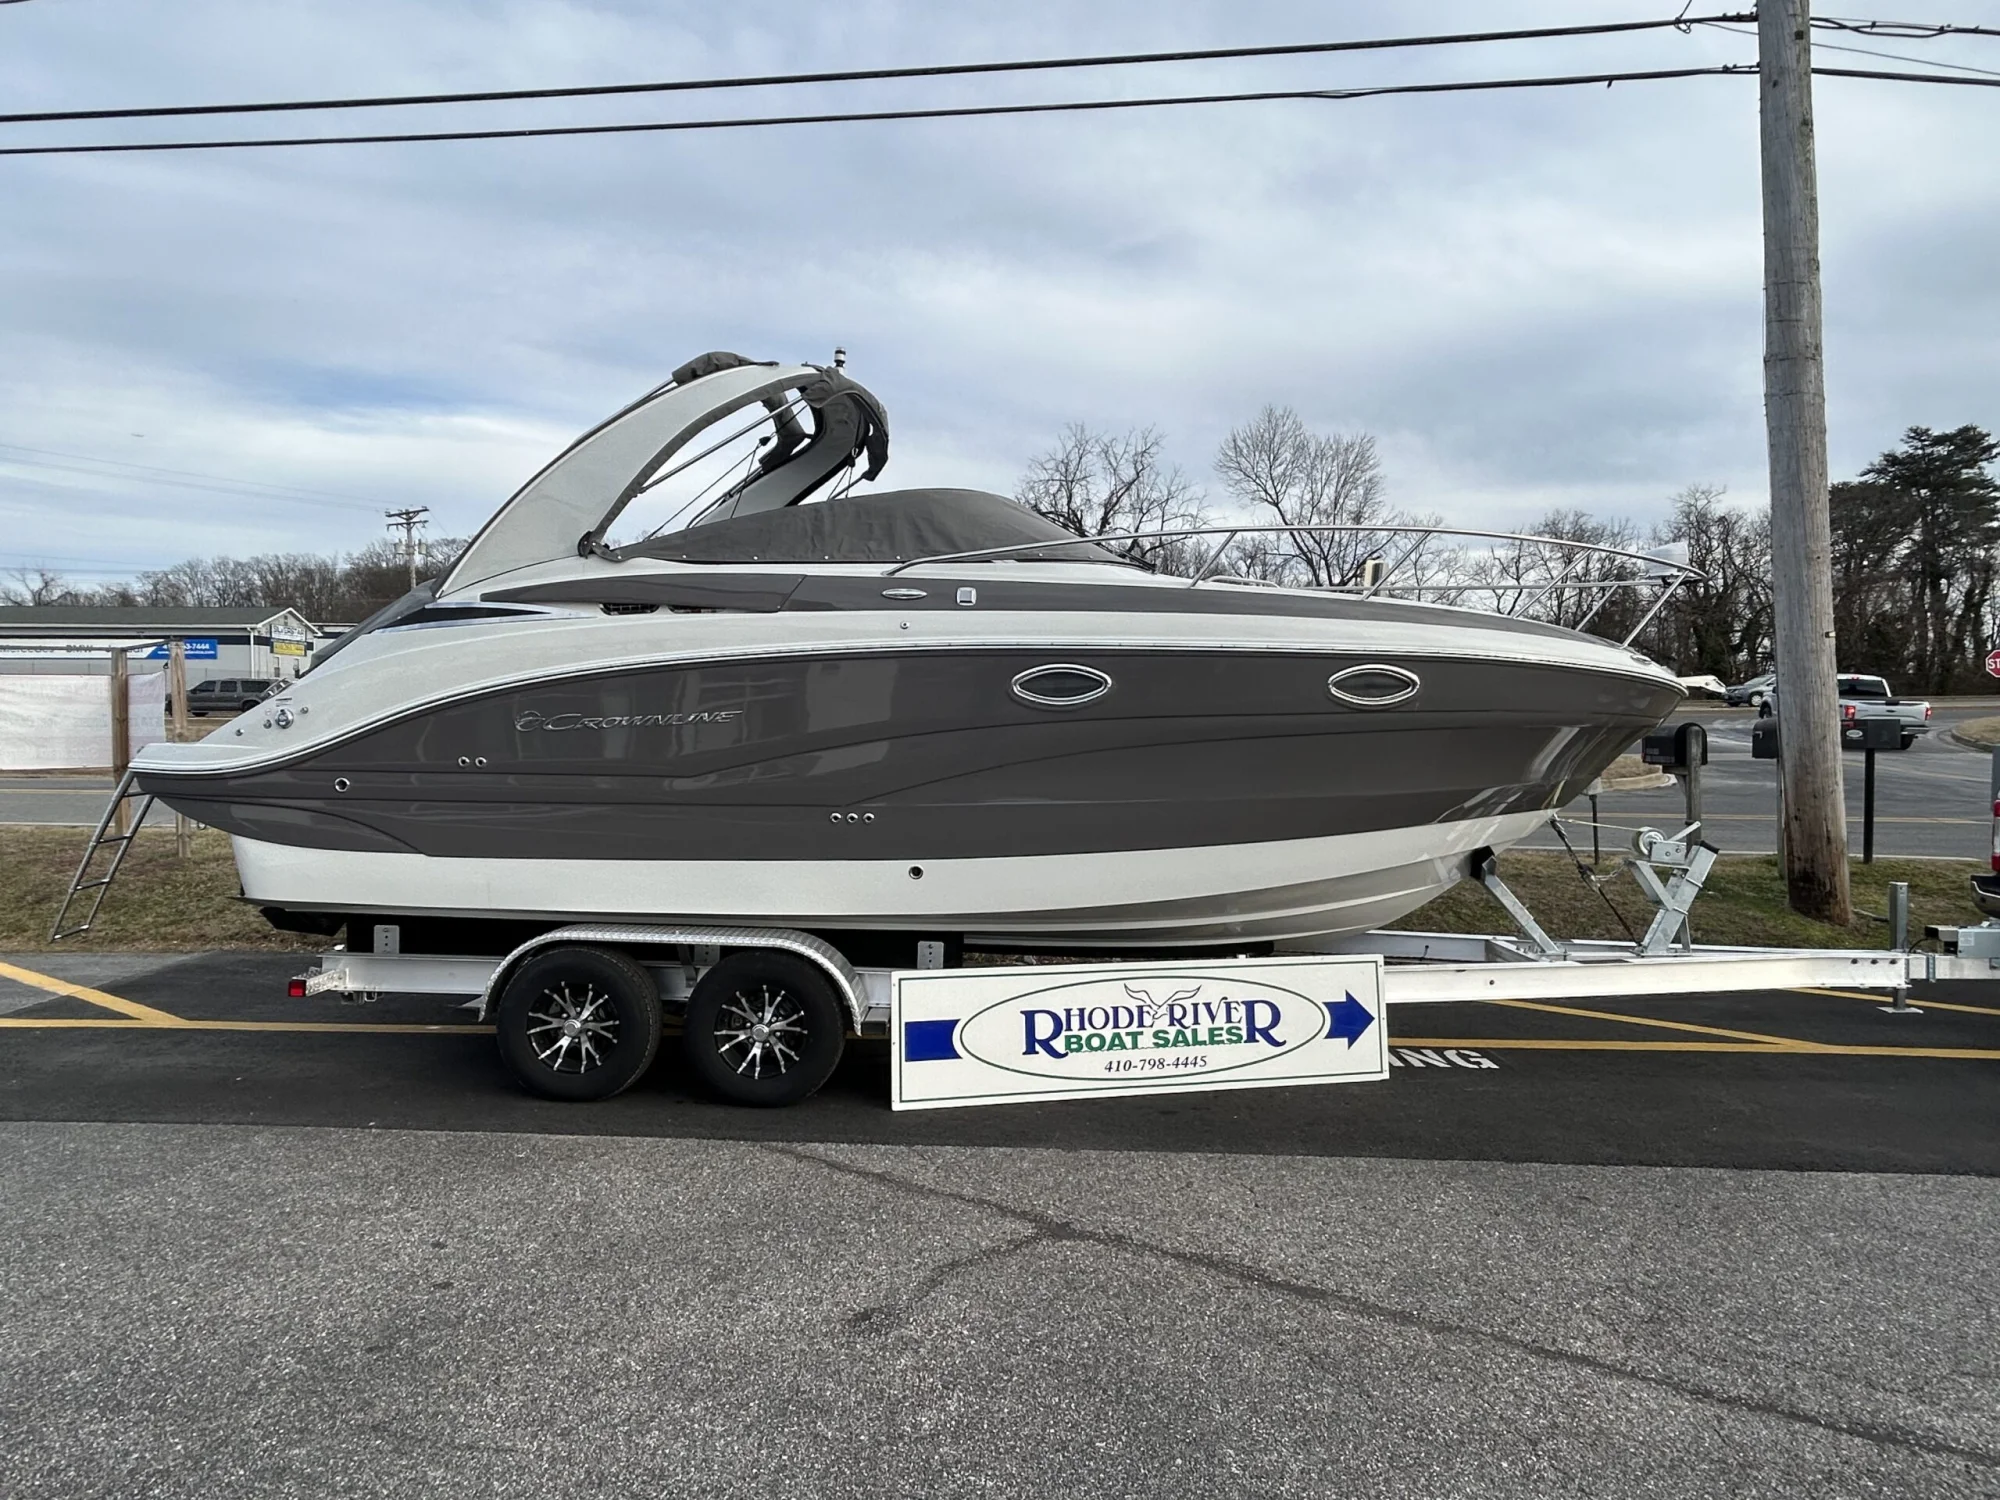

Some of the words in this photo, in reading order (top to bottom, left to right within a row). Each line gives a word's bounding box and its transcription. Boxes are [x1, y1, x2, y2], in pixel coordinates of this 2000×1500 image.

[543, 710, 743, 731] CROWNLINE
[1019, 1005, 1156, 1059] RHODE
[1167, 996, 1287, 1048] RIVER
[1064, 1031, 1144, 1053] BOAT
[1152, 1026, 1244, 1048] SALES
[1104, 1055, 1208, 1073] 410-798-4445
